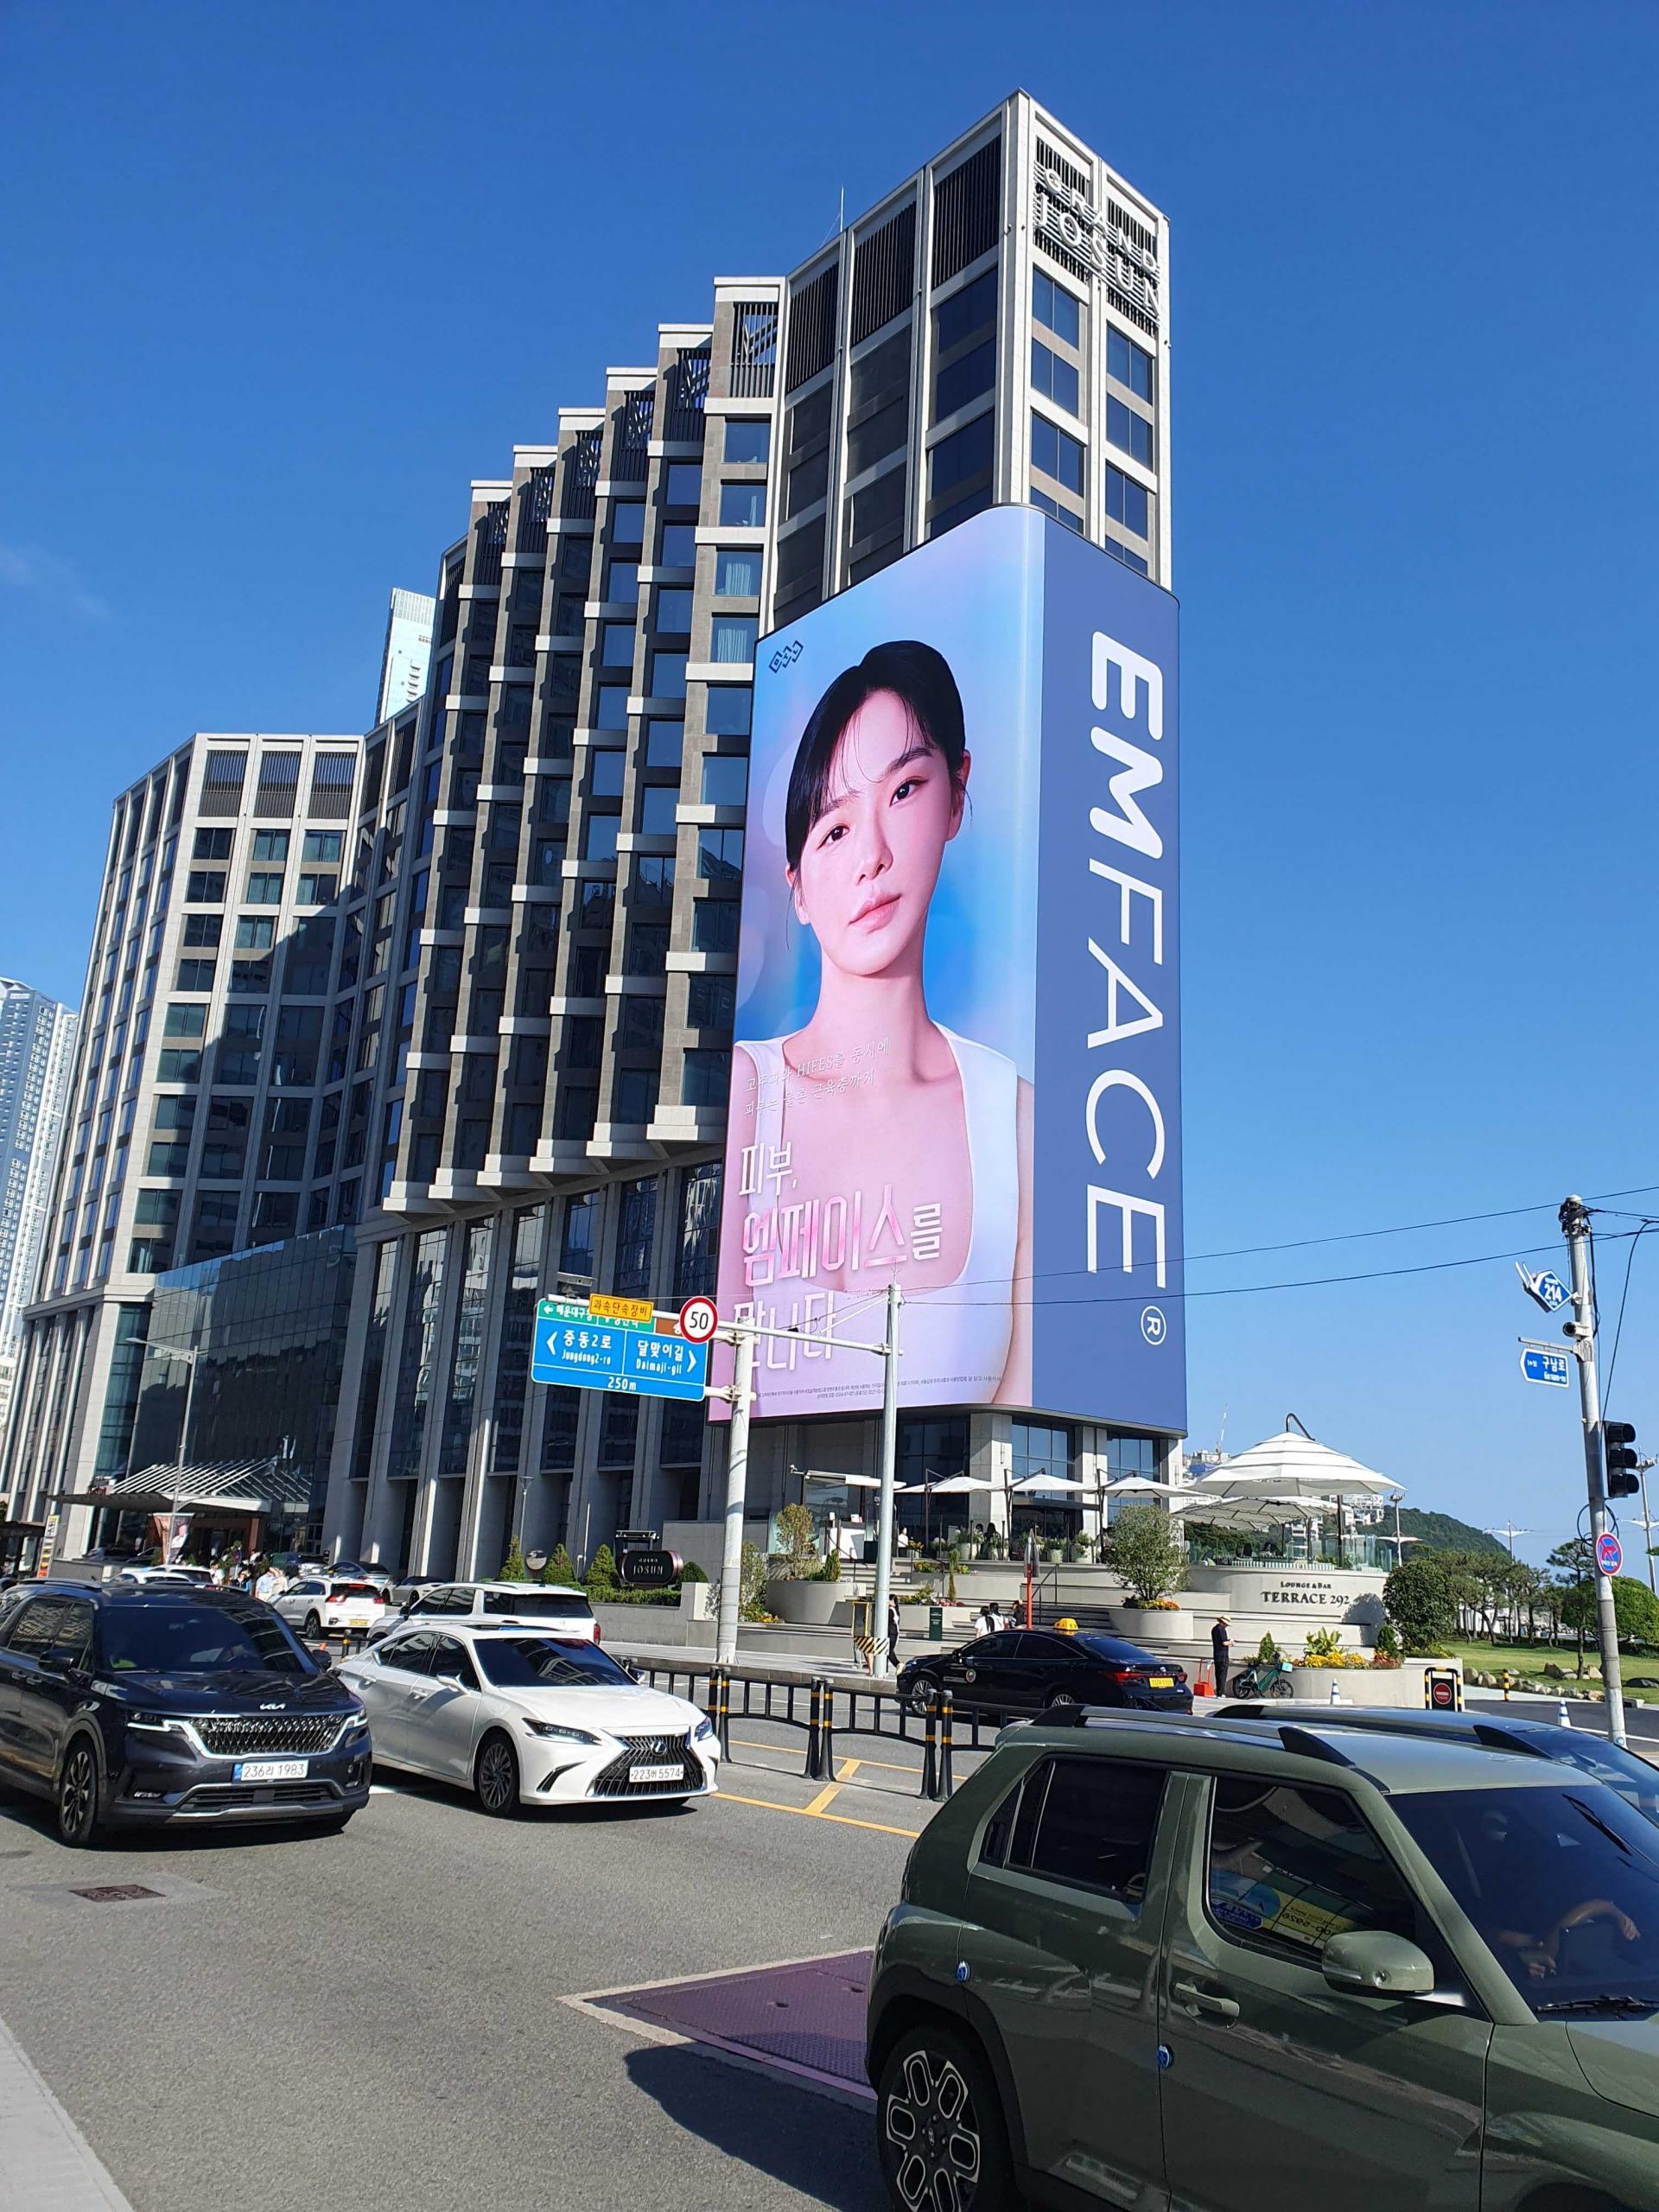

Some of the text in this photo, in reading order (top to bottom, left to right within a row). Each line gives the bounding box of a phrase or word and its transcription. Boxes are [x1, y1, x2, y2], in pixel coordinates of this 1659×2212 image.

[1044, 168, 1157, 274] GRAND
[1037, 192, 1160, 317] JOSUN
[1085, 631, 1166, 1288] EMFACE
[797, 1051, 845, 1078] HIFES를
[851, 1037, 889, 1064] 동시에
[739, 1141, 798, 1196] 피부,
[742, 1183, 943, 1287] 엠페이스를
[1544, 1283, 1562, 1302] 214
[594, 1300, 648, 1318] 과속단속장비
[690, 1311, 709, 1330] 50
[563, 1329, 612, 1349] 중동2로
[562, 1349, 611, 1365] Jungdong2-ro
[638, 1339, 683, 1362] 달맞이길
[636, 1358, 683, 1376] Dalmaji-gil
[1542, 1356, 1566, 1372] 구남로
[607, 1376, 637, 1391] 250m
[1261, 1591, 1350, 1608] TERRACE 292
[278, 1764, 305, 1777] 1983
[658, 1767, 681, 1779] 5574
